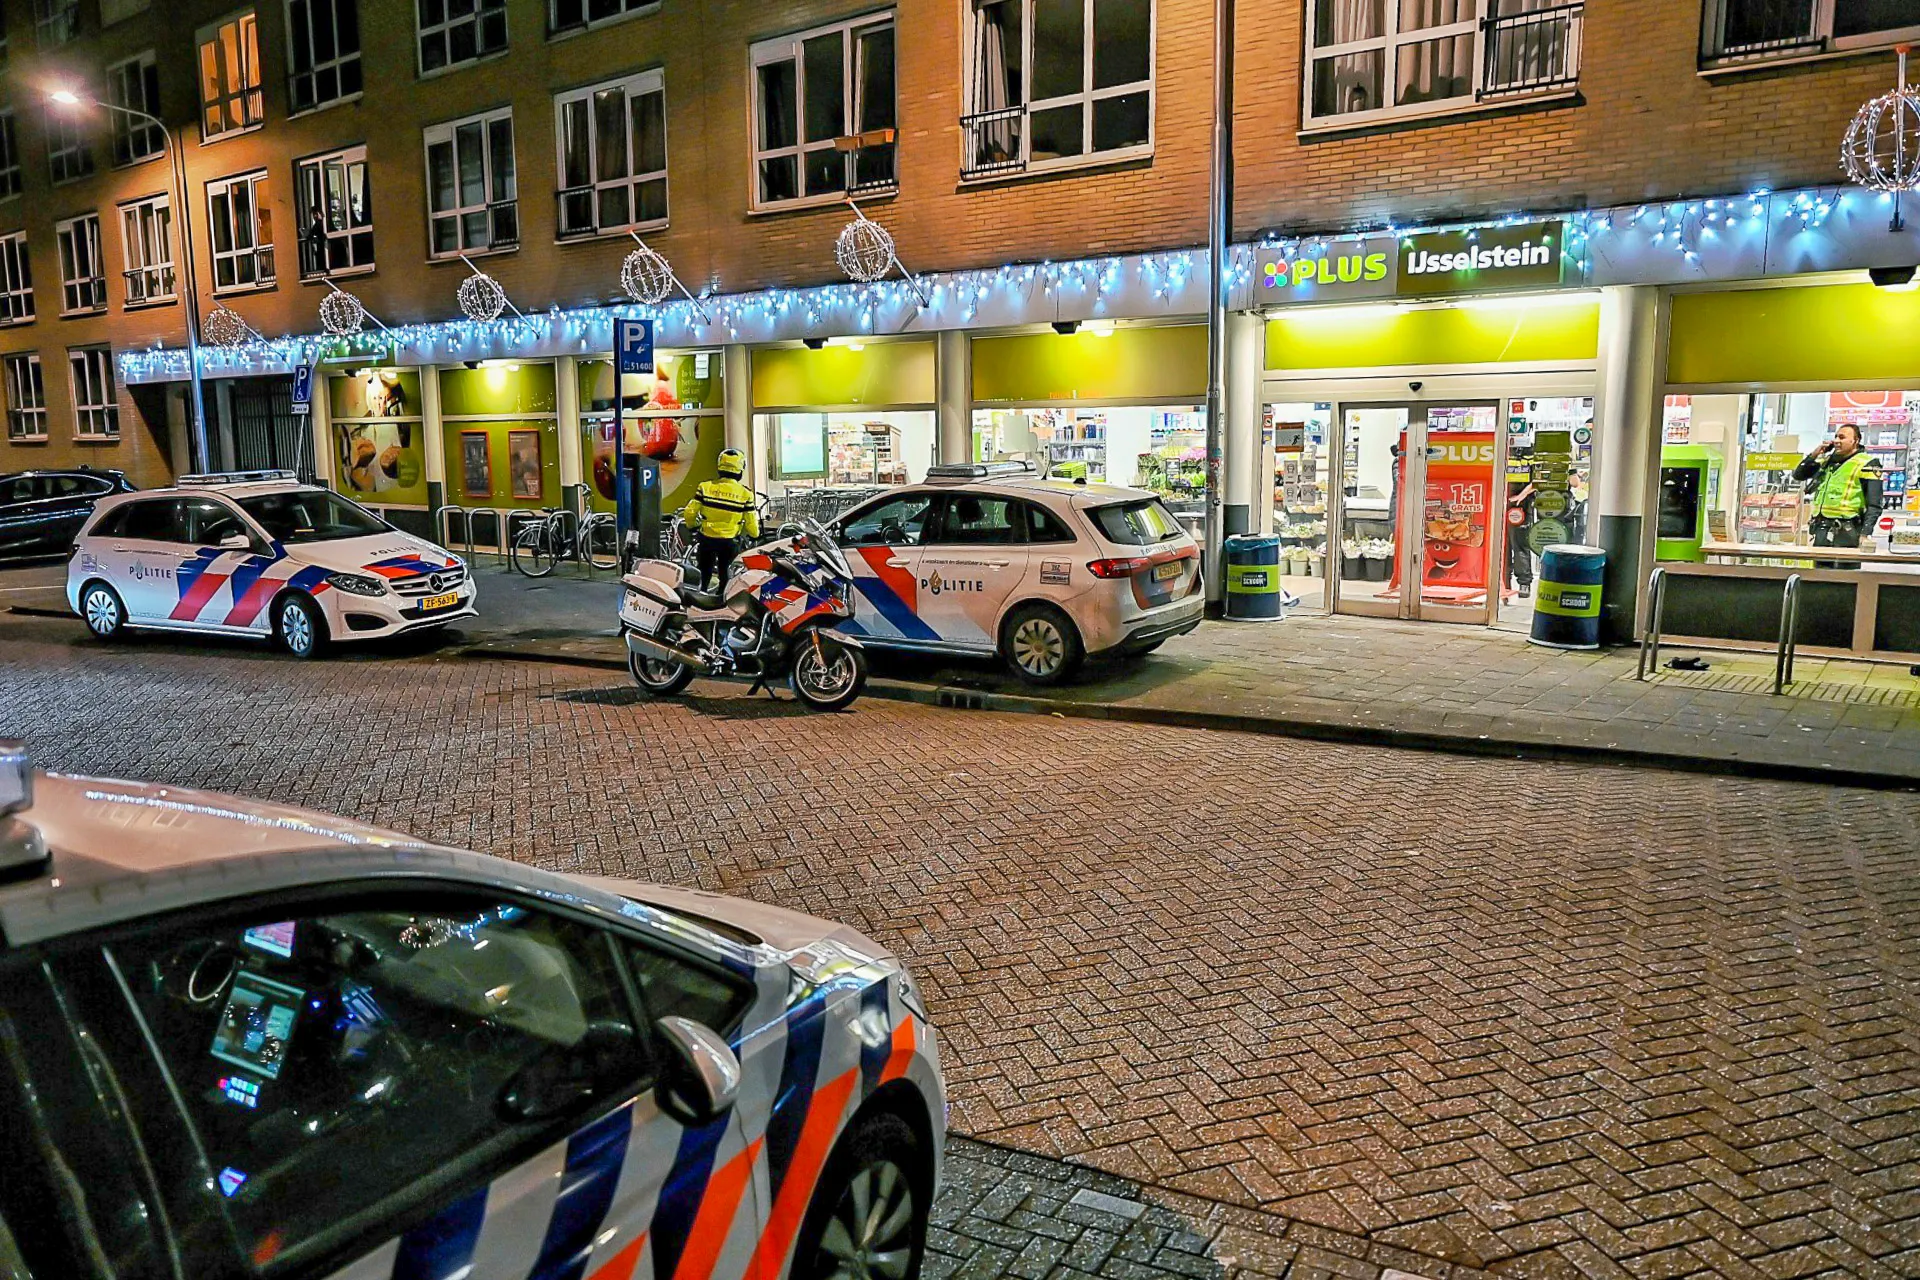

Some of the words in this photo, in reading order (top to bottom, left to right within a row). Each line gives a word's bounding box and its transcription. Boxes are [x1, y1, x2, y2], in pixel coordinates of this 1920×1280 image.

[1407, 241, 1550, 274] IJsselstein
[1292, 253, 1387, 285] PLUS
[623, 322, 646, 352] P
[297, 367, 308, 387] P
[1428, 445, 1494, 462] PLUS
[643, 469, 652, 486] P
[1451, 504, 1482, 512] GRATIS
[370, 546, 418, 556] POLITIE
[130, 566, 171, 580] POLITIE
[921, 578, 983, 595] POLITIE
[629, 600, 657, 617] POLITIE
